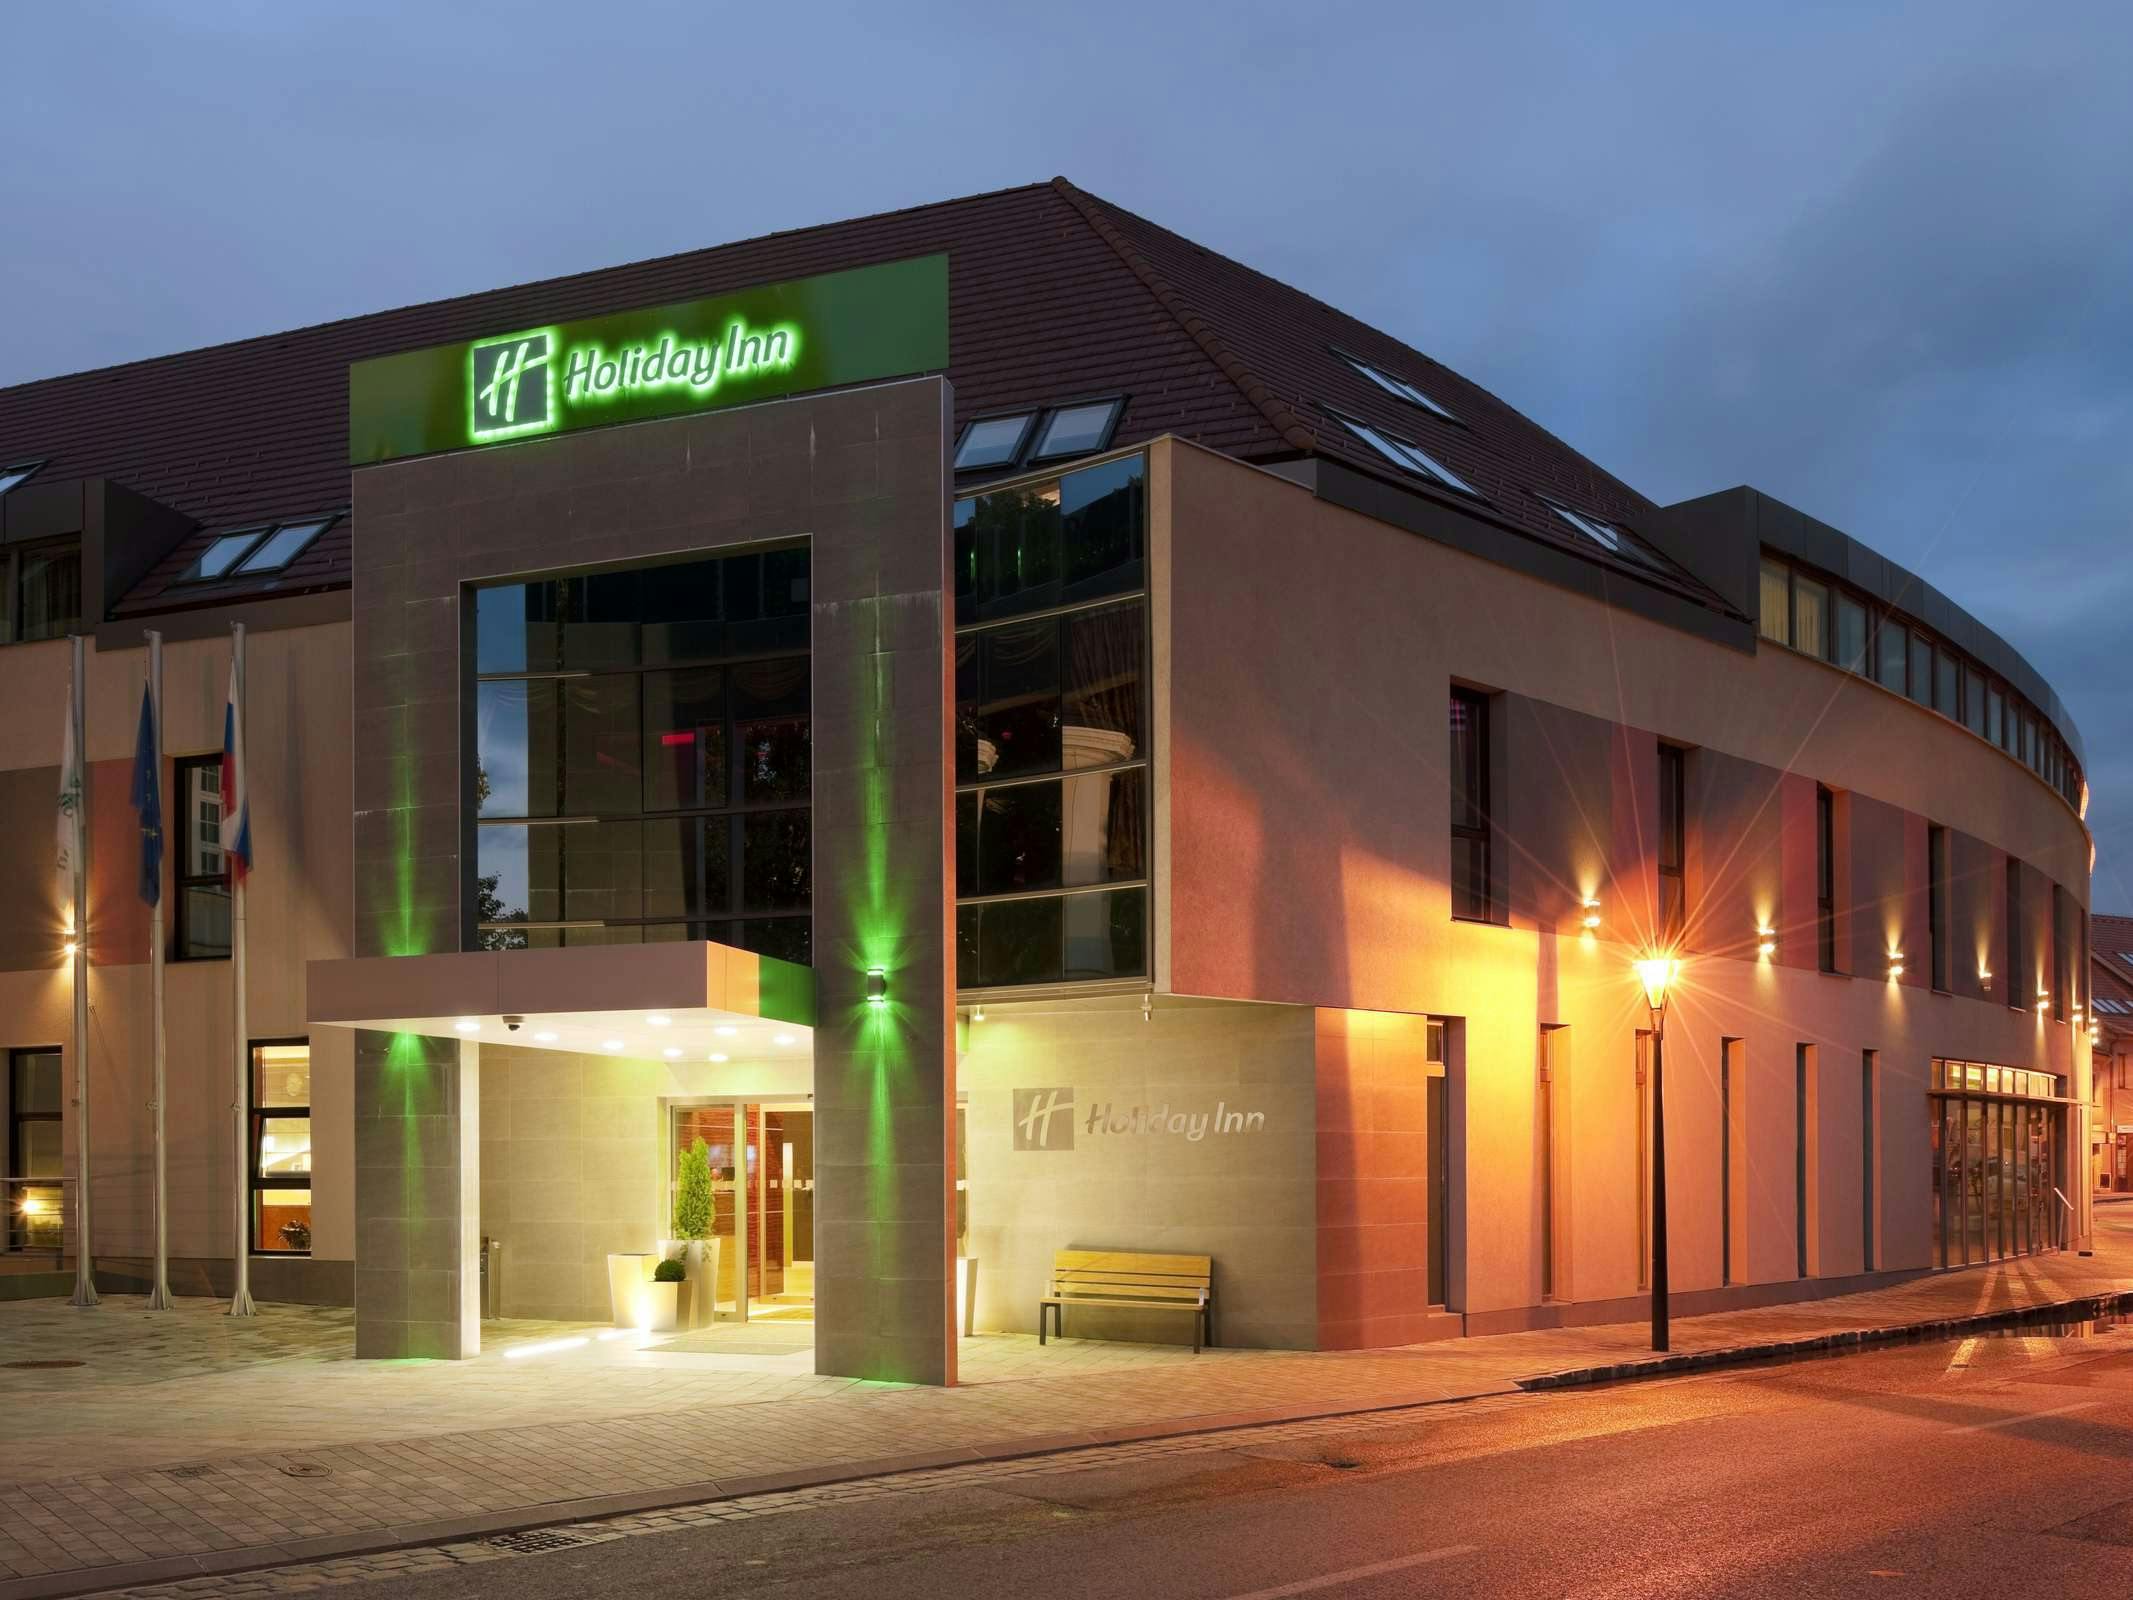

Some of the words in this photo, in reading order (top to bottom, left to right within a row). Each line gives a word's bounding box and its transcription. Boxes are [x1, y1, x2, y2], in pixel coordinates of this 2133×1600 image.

[563, 337, 721, 395] Holiday
[725, 324, 789, 370] Inn
[1084, 1102, 1209, 1142] Holiday
[1214, 1101, 1265, 1133] Inn
